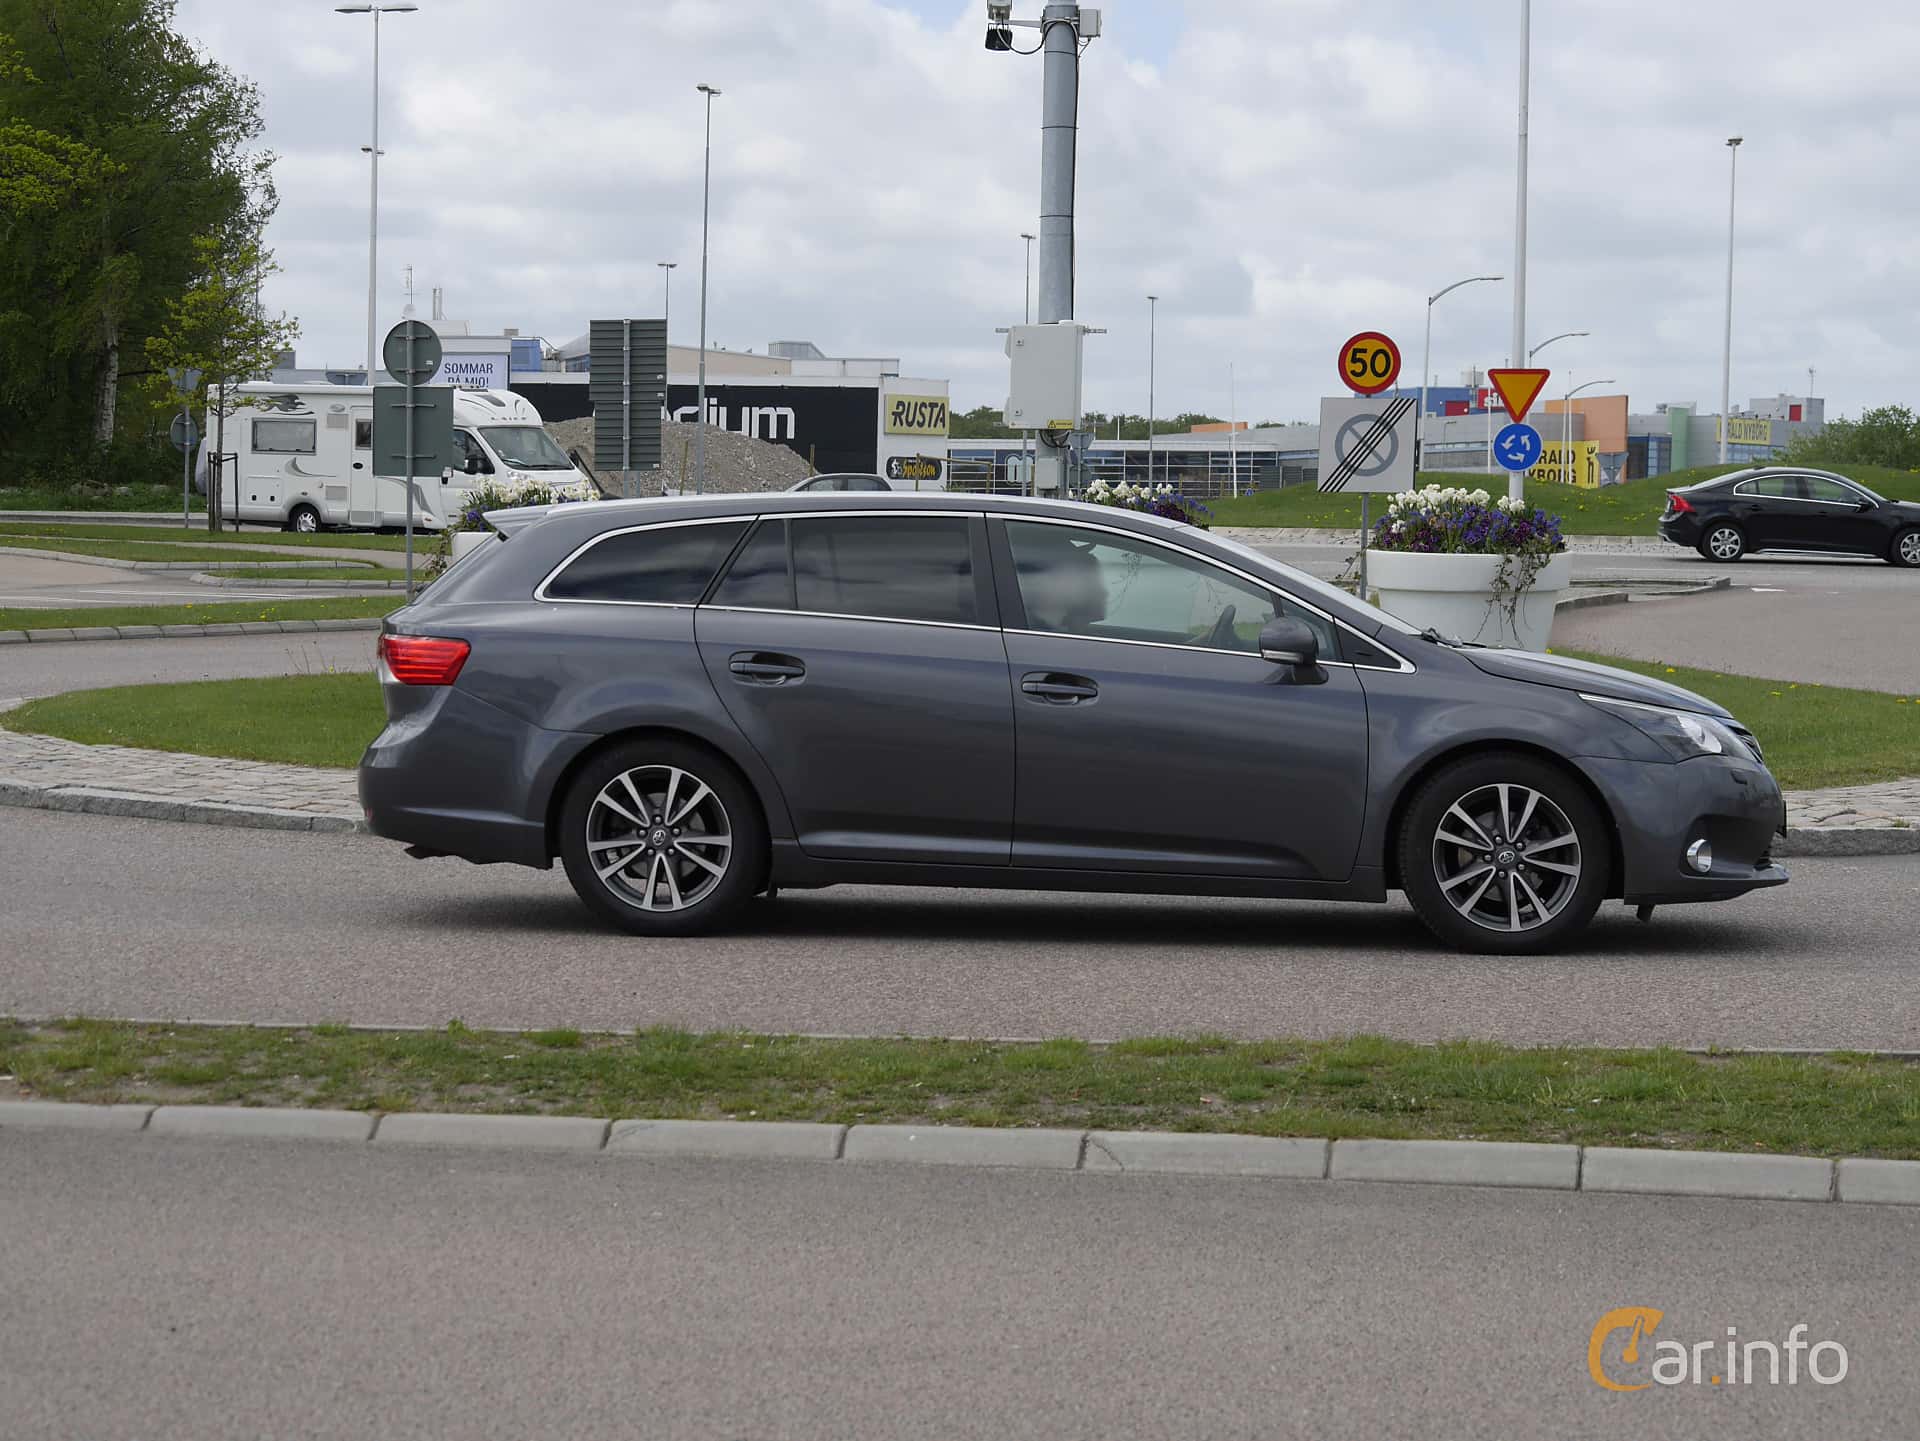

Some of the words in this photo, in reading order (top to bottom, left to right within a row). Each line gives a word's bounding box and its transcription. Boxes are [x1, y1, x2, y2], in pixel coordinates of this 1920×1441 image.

[444, 362, 494, 374] SOMMAR
[1350, 347, 1391, 379] 50
[891, 400, 946, 429] RUSTA
[1537, 449, 1576, 465] RALD
